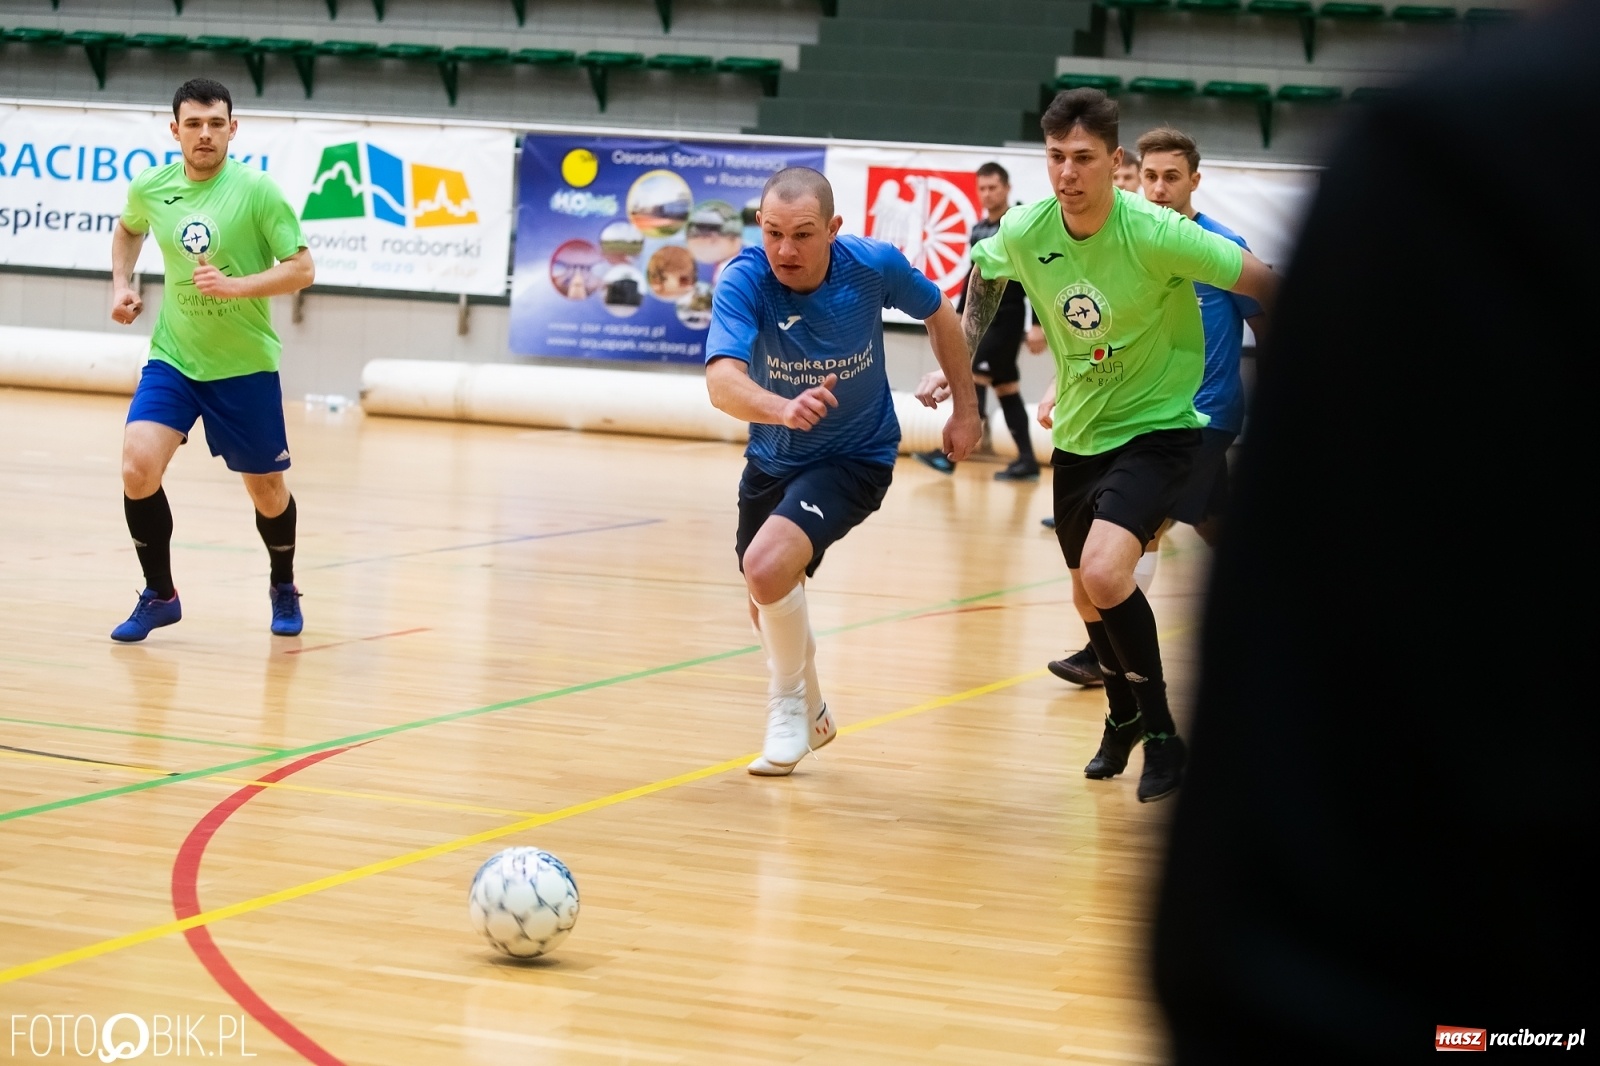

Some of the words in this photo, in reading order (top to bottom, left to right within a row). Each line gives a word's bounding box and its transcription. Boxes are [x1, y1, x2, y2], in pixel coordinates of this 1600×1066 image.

[304, 230, 367, 251] owiat
[1056, 286, 1106, 310] FOOTBALL
[769, 370, 830, 386] Metallba
[839, 353, 874, 380] GmbH
